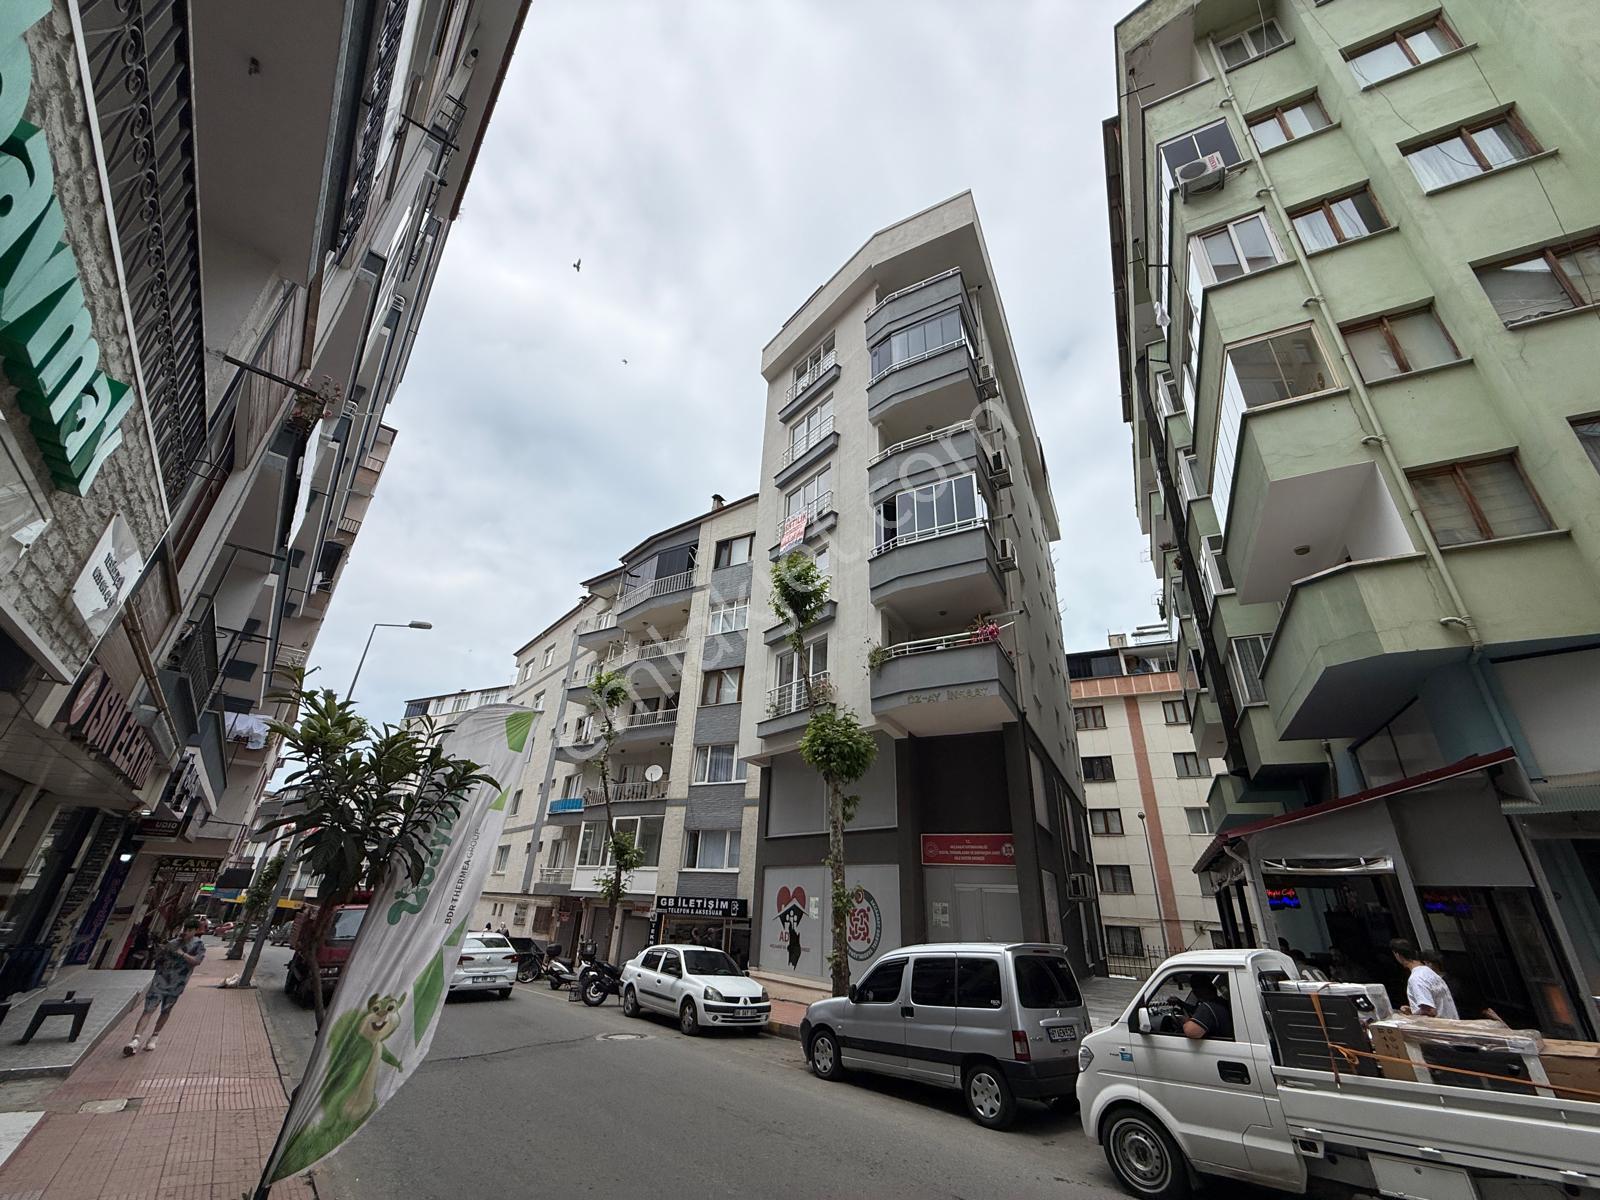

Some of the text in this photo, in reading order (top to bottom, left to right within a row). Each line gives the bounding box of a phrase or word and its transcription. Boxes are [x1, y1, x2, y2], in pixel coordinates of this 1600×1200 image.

[444, 829, 481, 924] BDR THERMEA GROUP
[660, 897, 729, 910] GB İLETİŞİM
